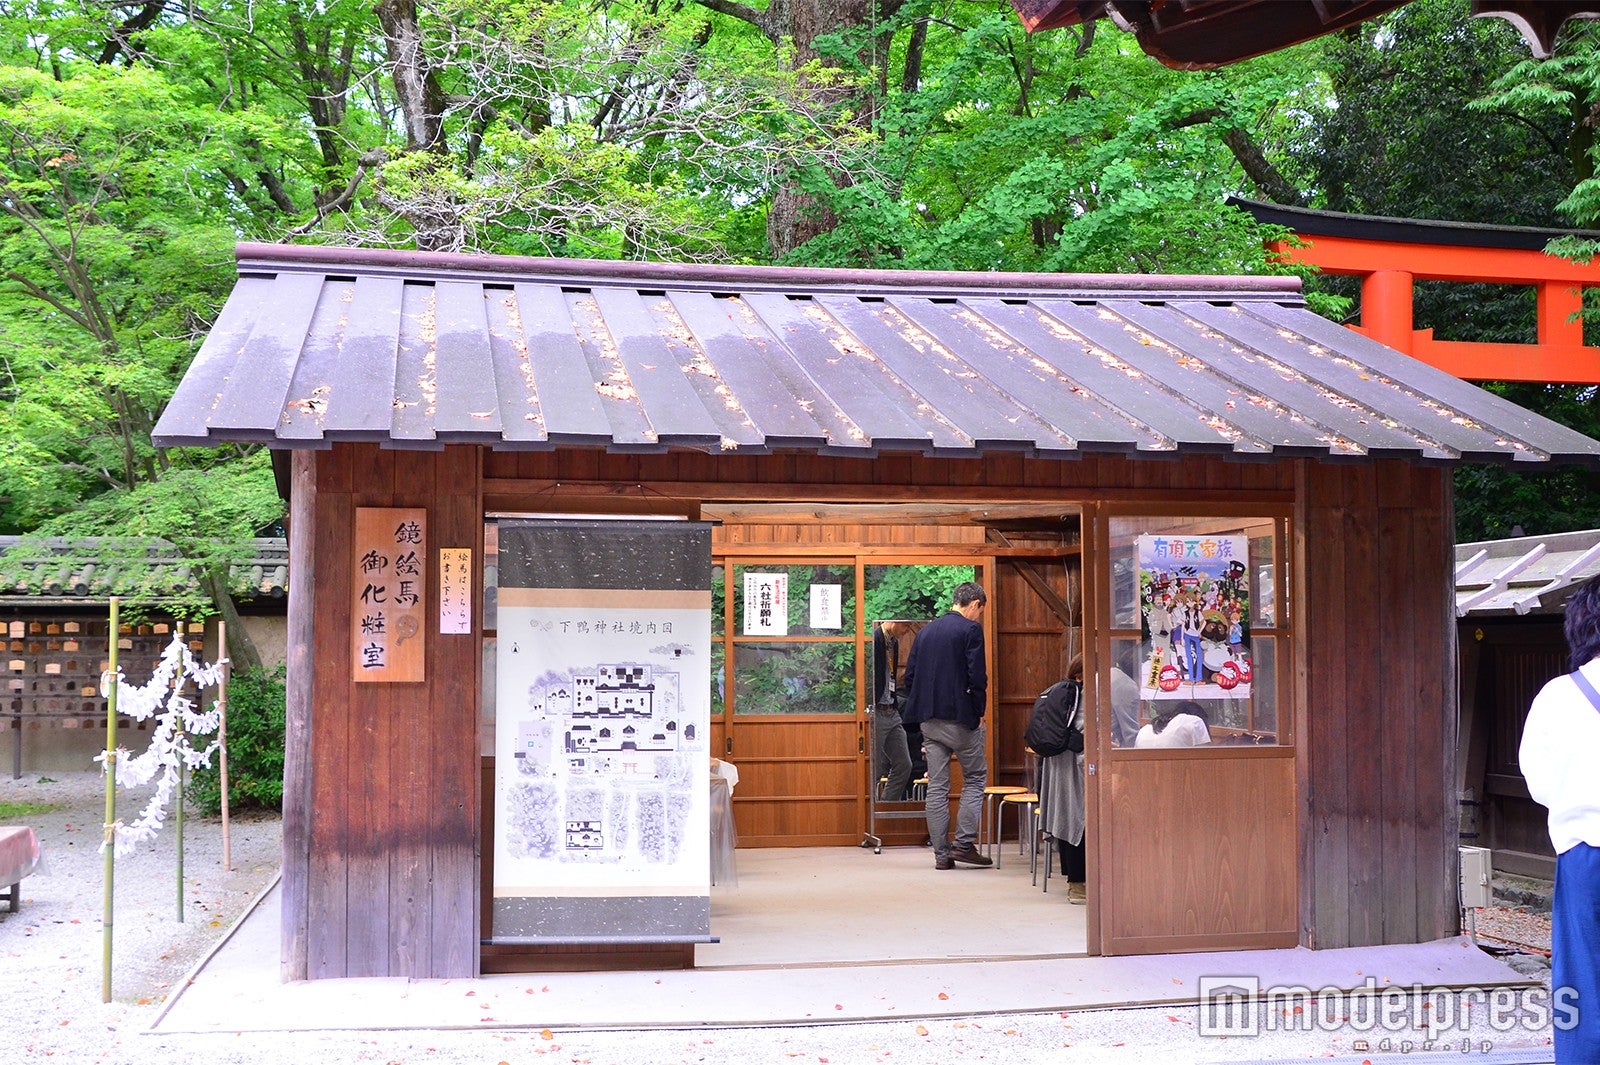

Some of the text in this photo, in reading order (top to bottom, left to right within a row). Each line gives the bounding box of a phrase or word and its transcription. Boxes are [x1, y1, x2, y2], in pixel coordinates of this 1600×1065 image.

[394, 521, 422, 607] 鏡絵馬
[1153, 537, 1234, 558] 有頂天家族
[360, 550, 388, 668] 御化粧室
[442, 552, 451, 617] お書き下さい
[760, 583, 771, 626] 六社祈願札
[560, 620, 673, 635] 下鴨神社境内図
